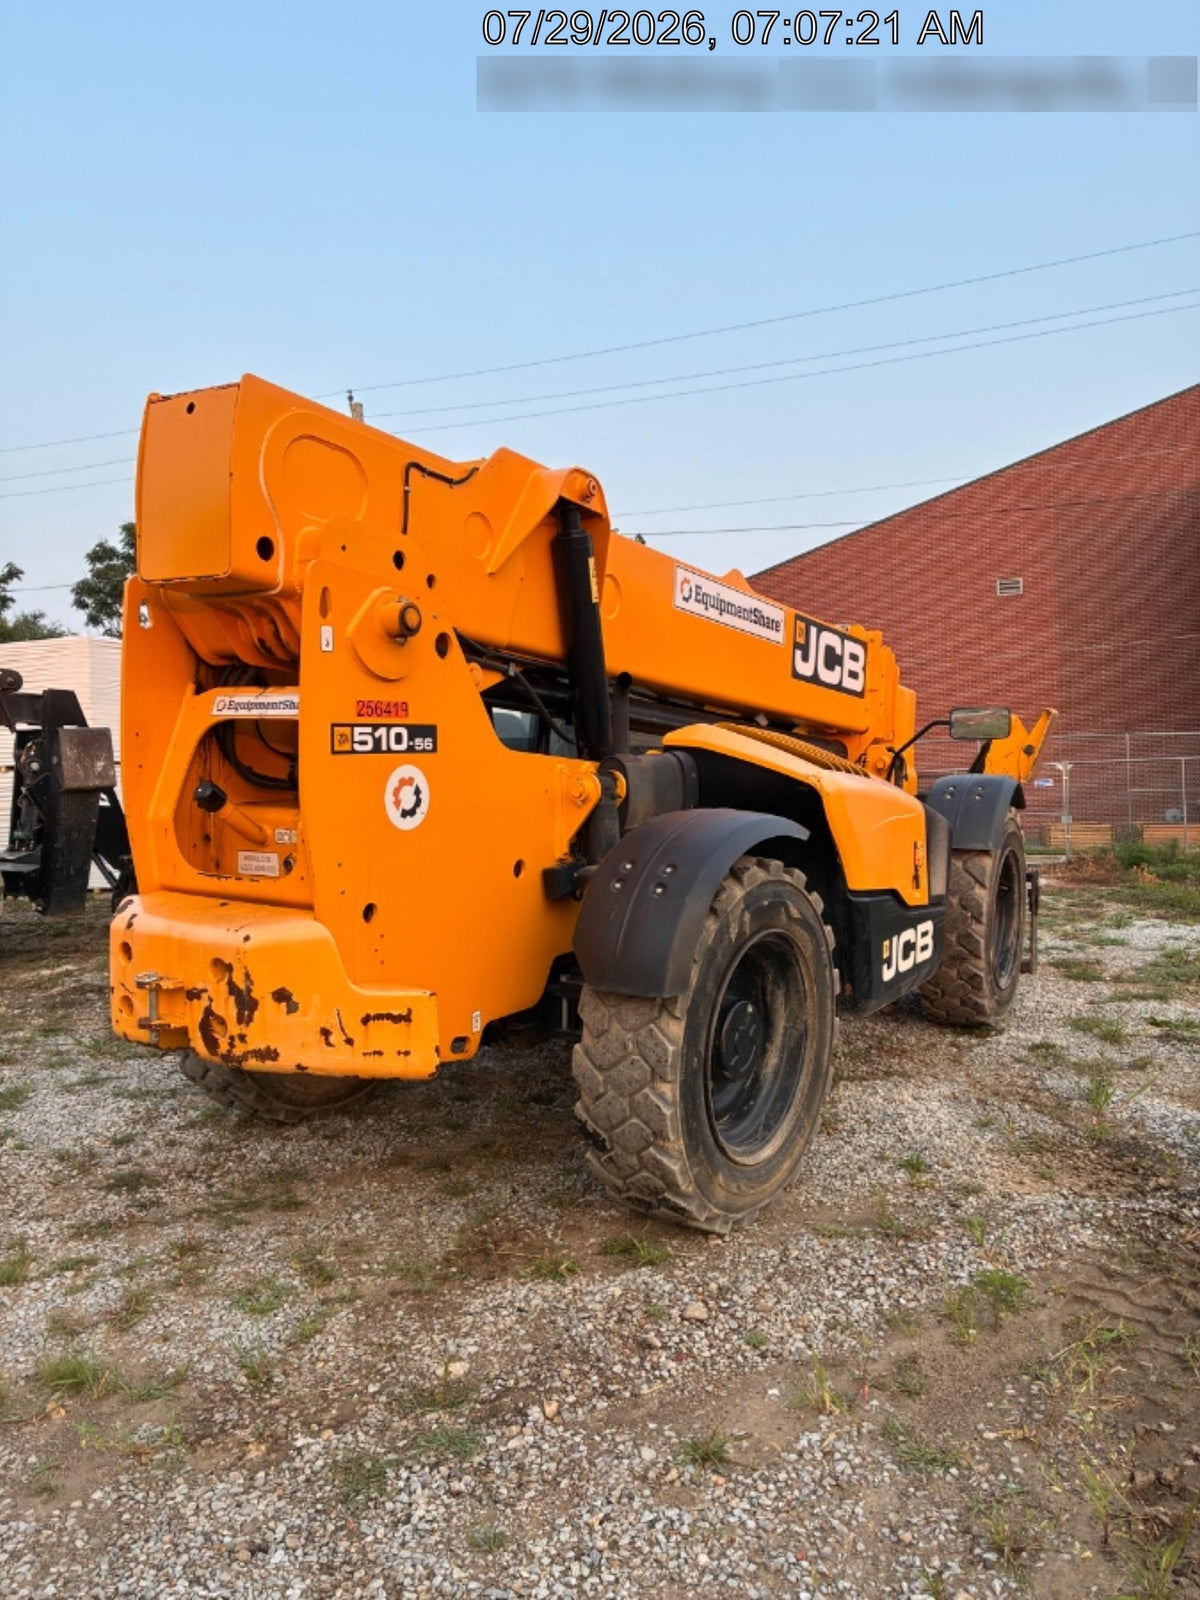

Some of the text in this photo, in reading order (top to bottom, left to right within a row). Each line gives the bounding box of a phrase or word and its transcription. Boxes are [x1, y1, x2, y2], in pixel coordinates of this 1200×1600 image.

[694, 584, 781, 632] EquipmentShare
[794, 624, 865, 693] JCB
[356, 700, 409, 718] 256419
[882, 920, 934, 982] JCB
